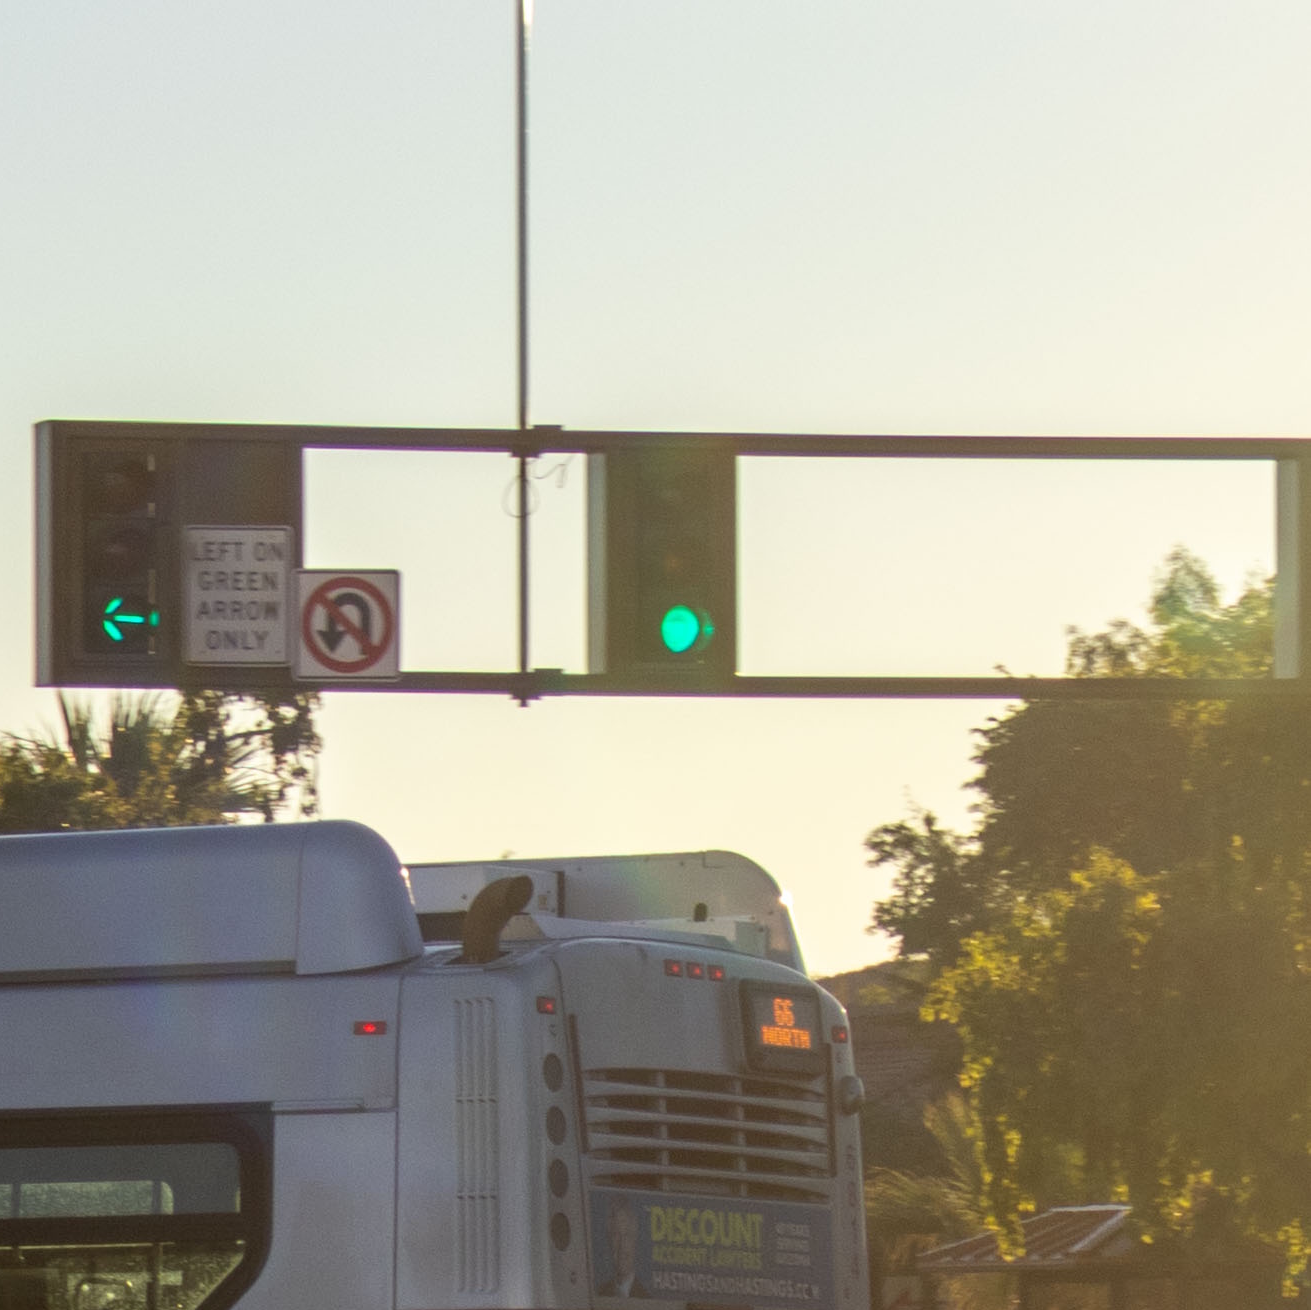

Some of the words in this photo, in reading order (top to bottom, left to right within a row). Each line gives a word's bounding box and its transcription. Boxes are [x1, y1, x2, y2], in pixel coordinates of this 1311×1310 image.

[191, 541, 245, 561] LEFT
[253, 541, 284, 561] ON
[197, 571, 279, 591] GREEN
[196, 601, 279, 620] ARROW
[206, 630, 269, 650] ONLY
[762, 1025, 810, 1049] NORTH
[650, 1205, 763, 1248] DISCOUNT
